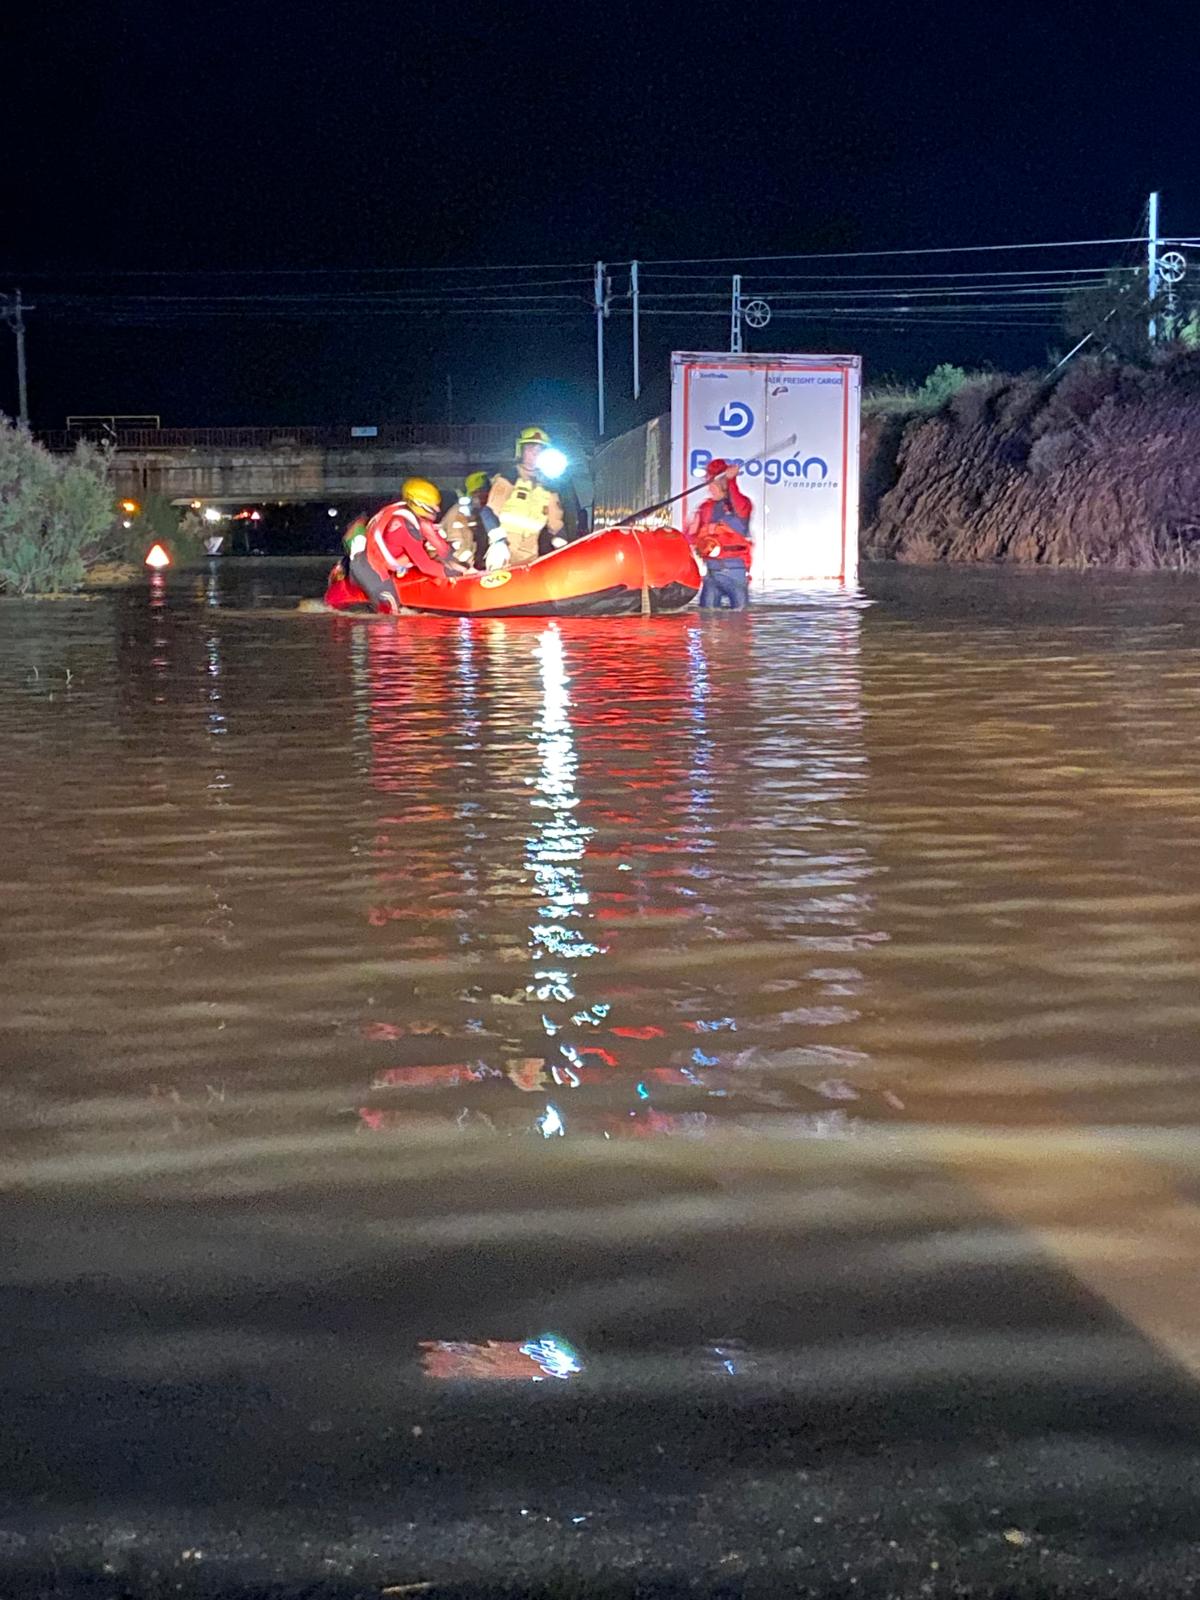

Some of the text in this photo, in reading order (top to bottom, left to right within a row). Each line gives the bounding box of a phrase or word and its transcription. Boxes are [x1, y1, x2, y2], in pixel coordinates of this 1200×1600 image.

[767, 377, 781, 385] AIR
[817, 378, 843, 386] CARGO
[691, 450, 828, 485] Bogán
[783, 480, 838, 489] Transporte
